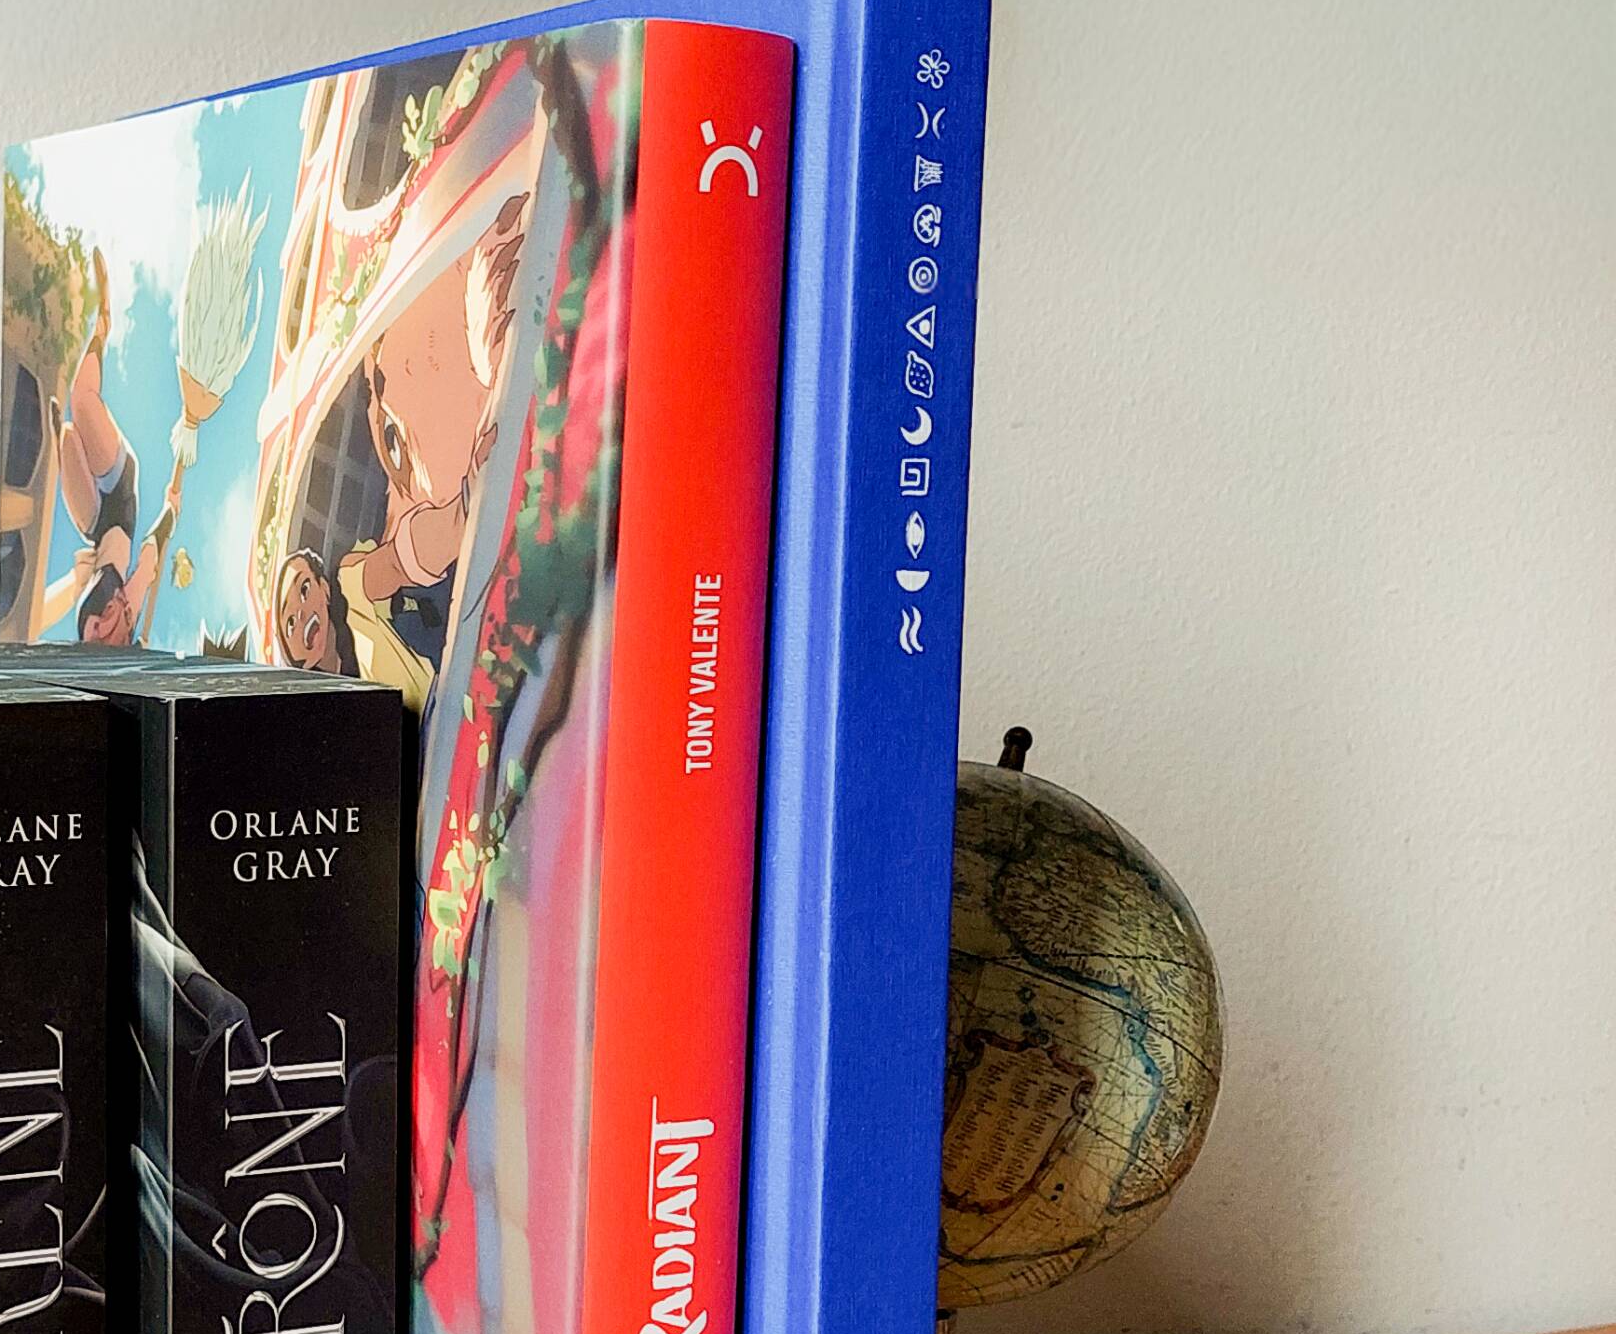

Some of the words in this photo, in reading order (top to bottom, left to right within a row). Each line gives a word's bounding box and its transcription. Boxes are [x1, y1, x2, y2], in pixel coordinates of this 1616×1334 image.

[689, 574, 722, 695] VALENTE
[686, 701, 714, 774] TONY
[210, 807, 360, 840] ORLANE
[233, 847, 339, 882] GRAY
